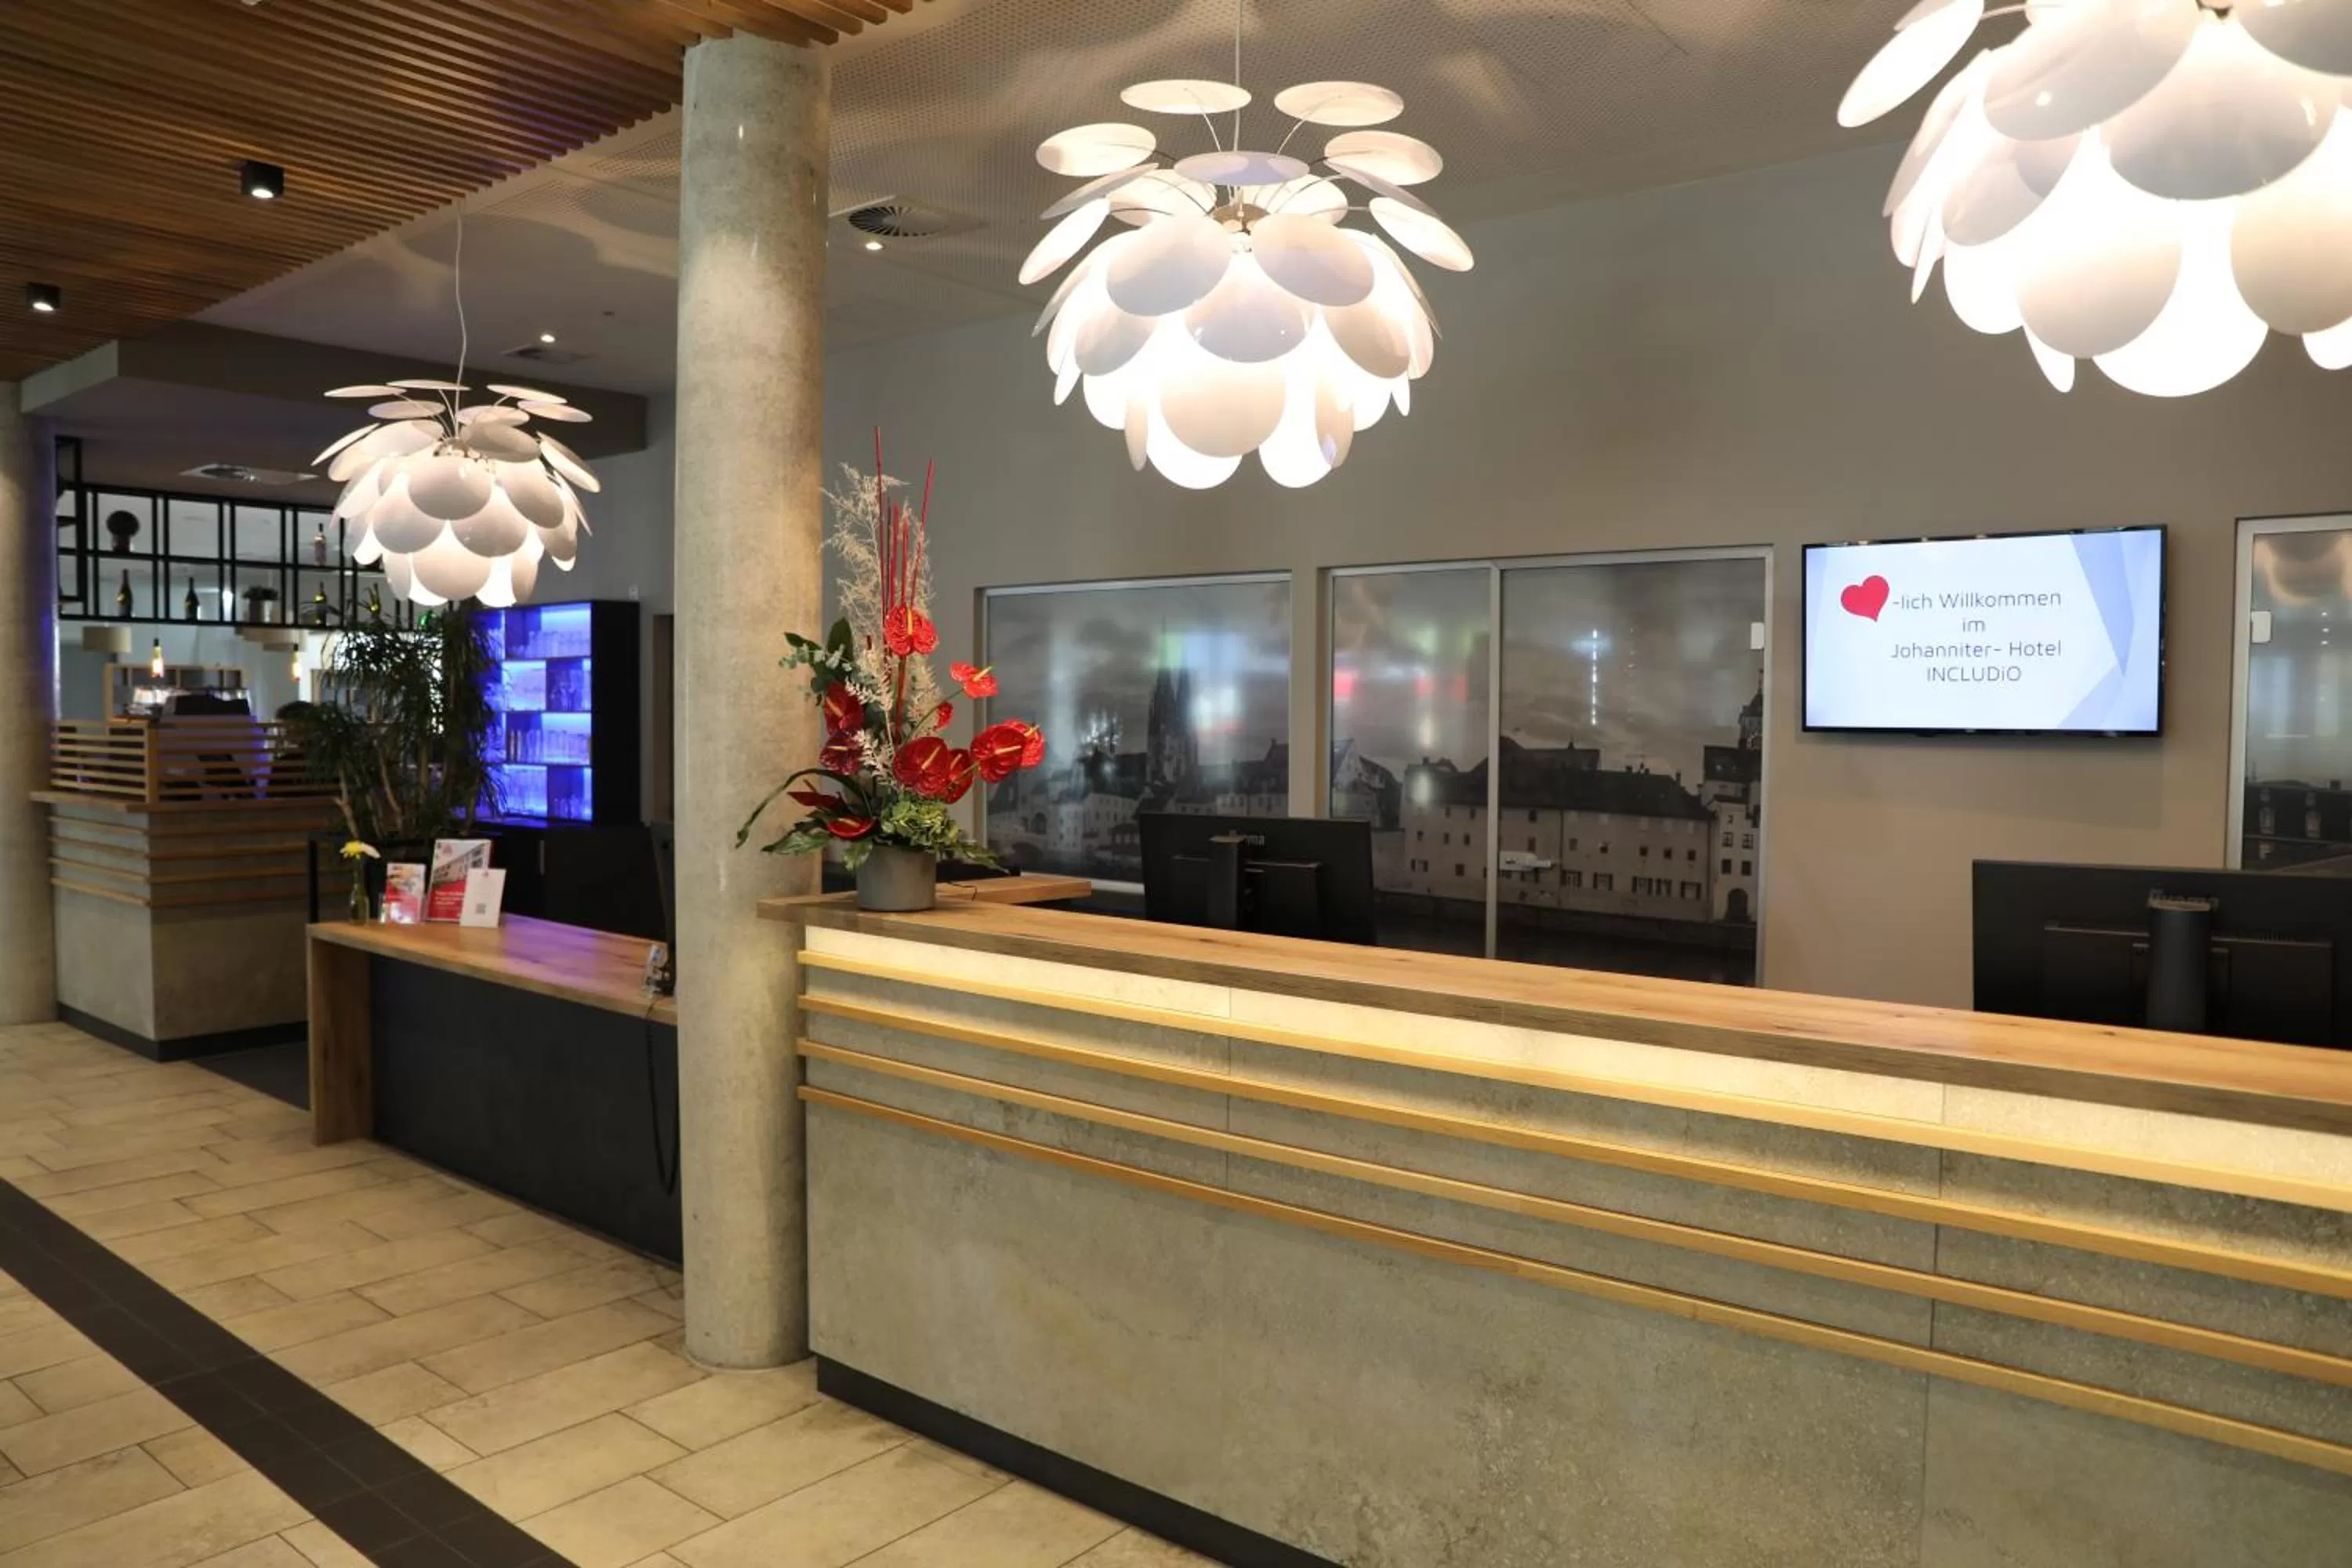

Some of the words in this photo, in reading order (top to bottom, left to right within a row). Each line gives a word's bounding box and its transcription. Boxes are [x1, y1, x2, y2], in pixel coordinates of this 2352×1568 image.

[1892, 593, 1933, 609] -lich
[1939, 592, 2061, 608] Willkommen
[1962, 618, 1986, 632] im
[2009, 639, 2061, 656] Hotel
[1926, 665, 2022, 682] INCLUDiO
